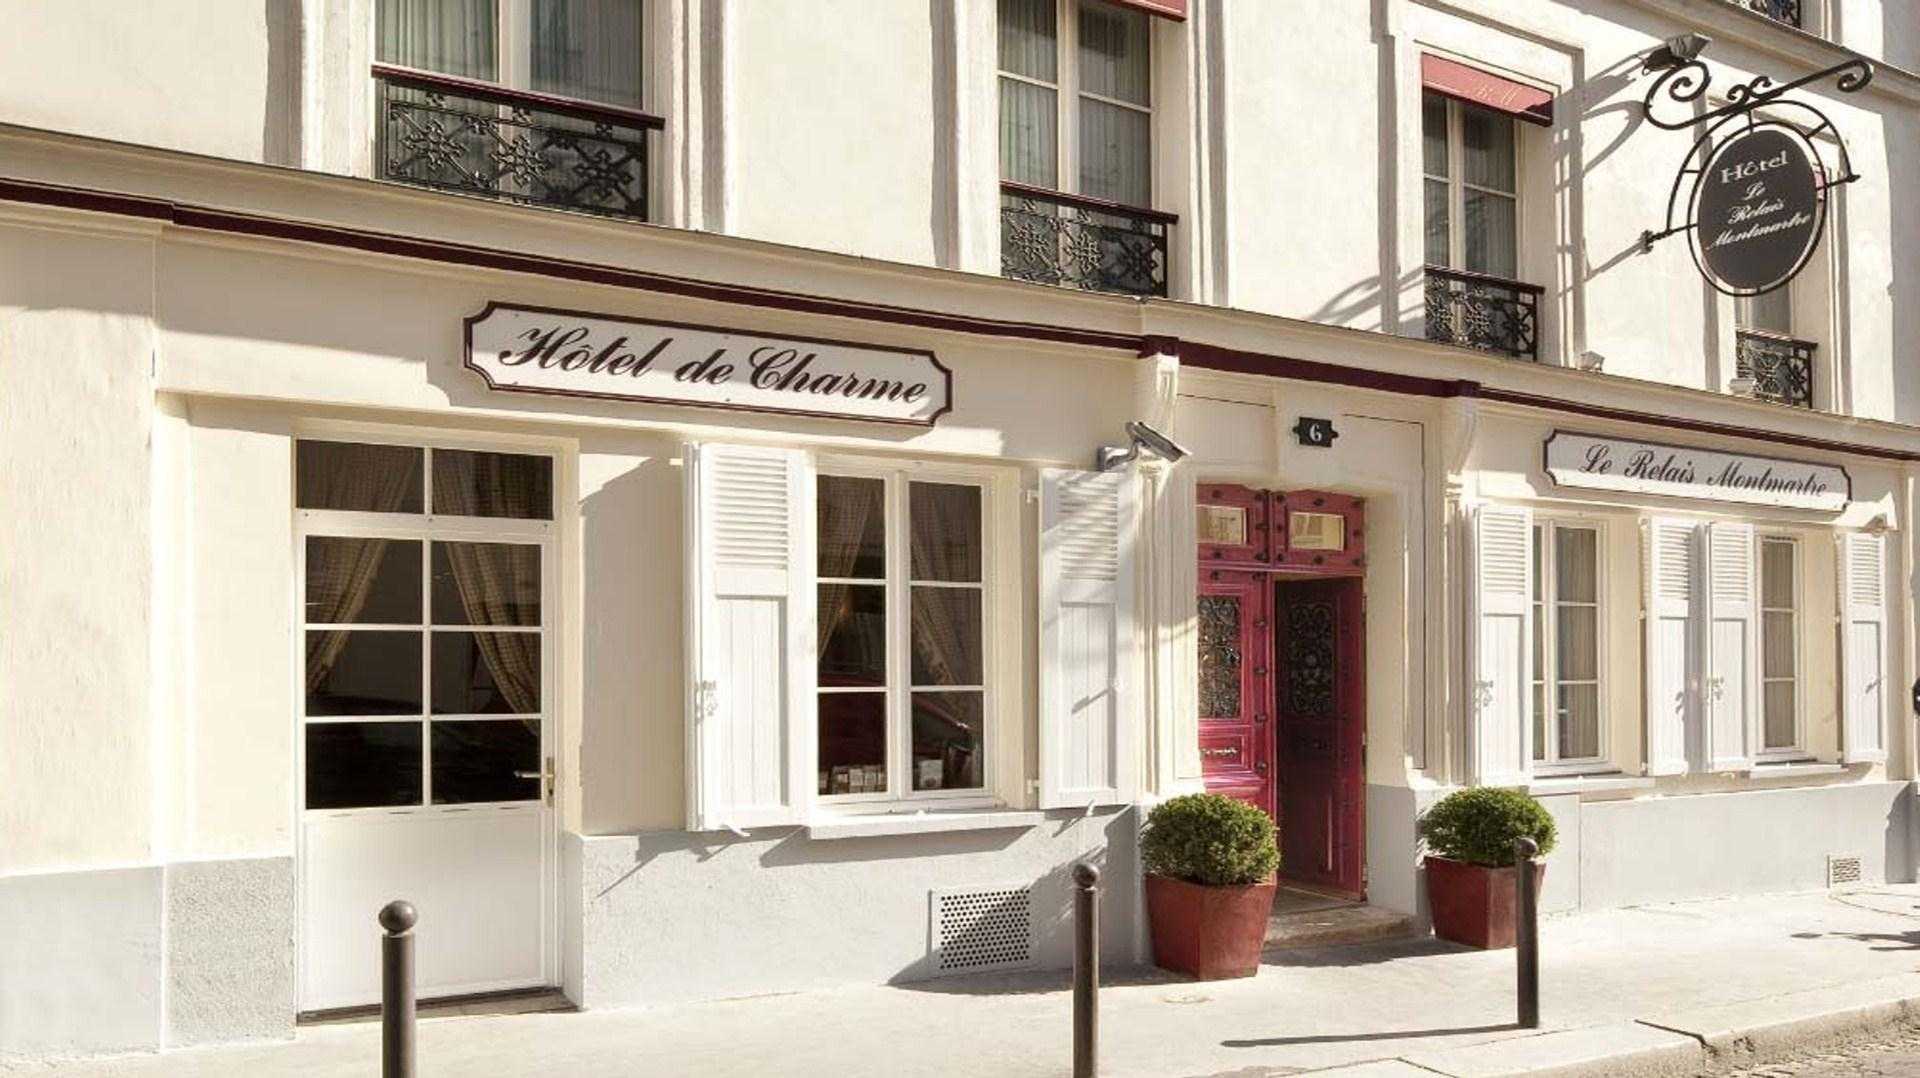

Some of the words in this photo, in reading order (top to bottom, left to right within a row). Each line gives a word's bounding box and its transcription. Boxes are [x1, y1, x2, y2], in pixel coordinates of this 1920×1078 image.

[1721, 151, 1789, 184] Hôtel
[1742, 182, 1766, 200] Le
[1728, 198, 1785, 224] Relais
[1706, 212, 1811, 249] Montmartre
[499, 326, 674, 377] Hôtel
[675, 348, 734, 384] de
[749, 345, 928, 403] Charme
[1309, 423, 1323, 441] 6
[1580, 443, 1612, 475] Le
[1625, 450, 1696, 484] Relais
[1707, 462, 1827, 498] Montmartre
